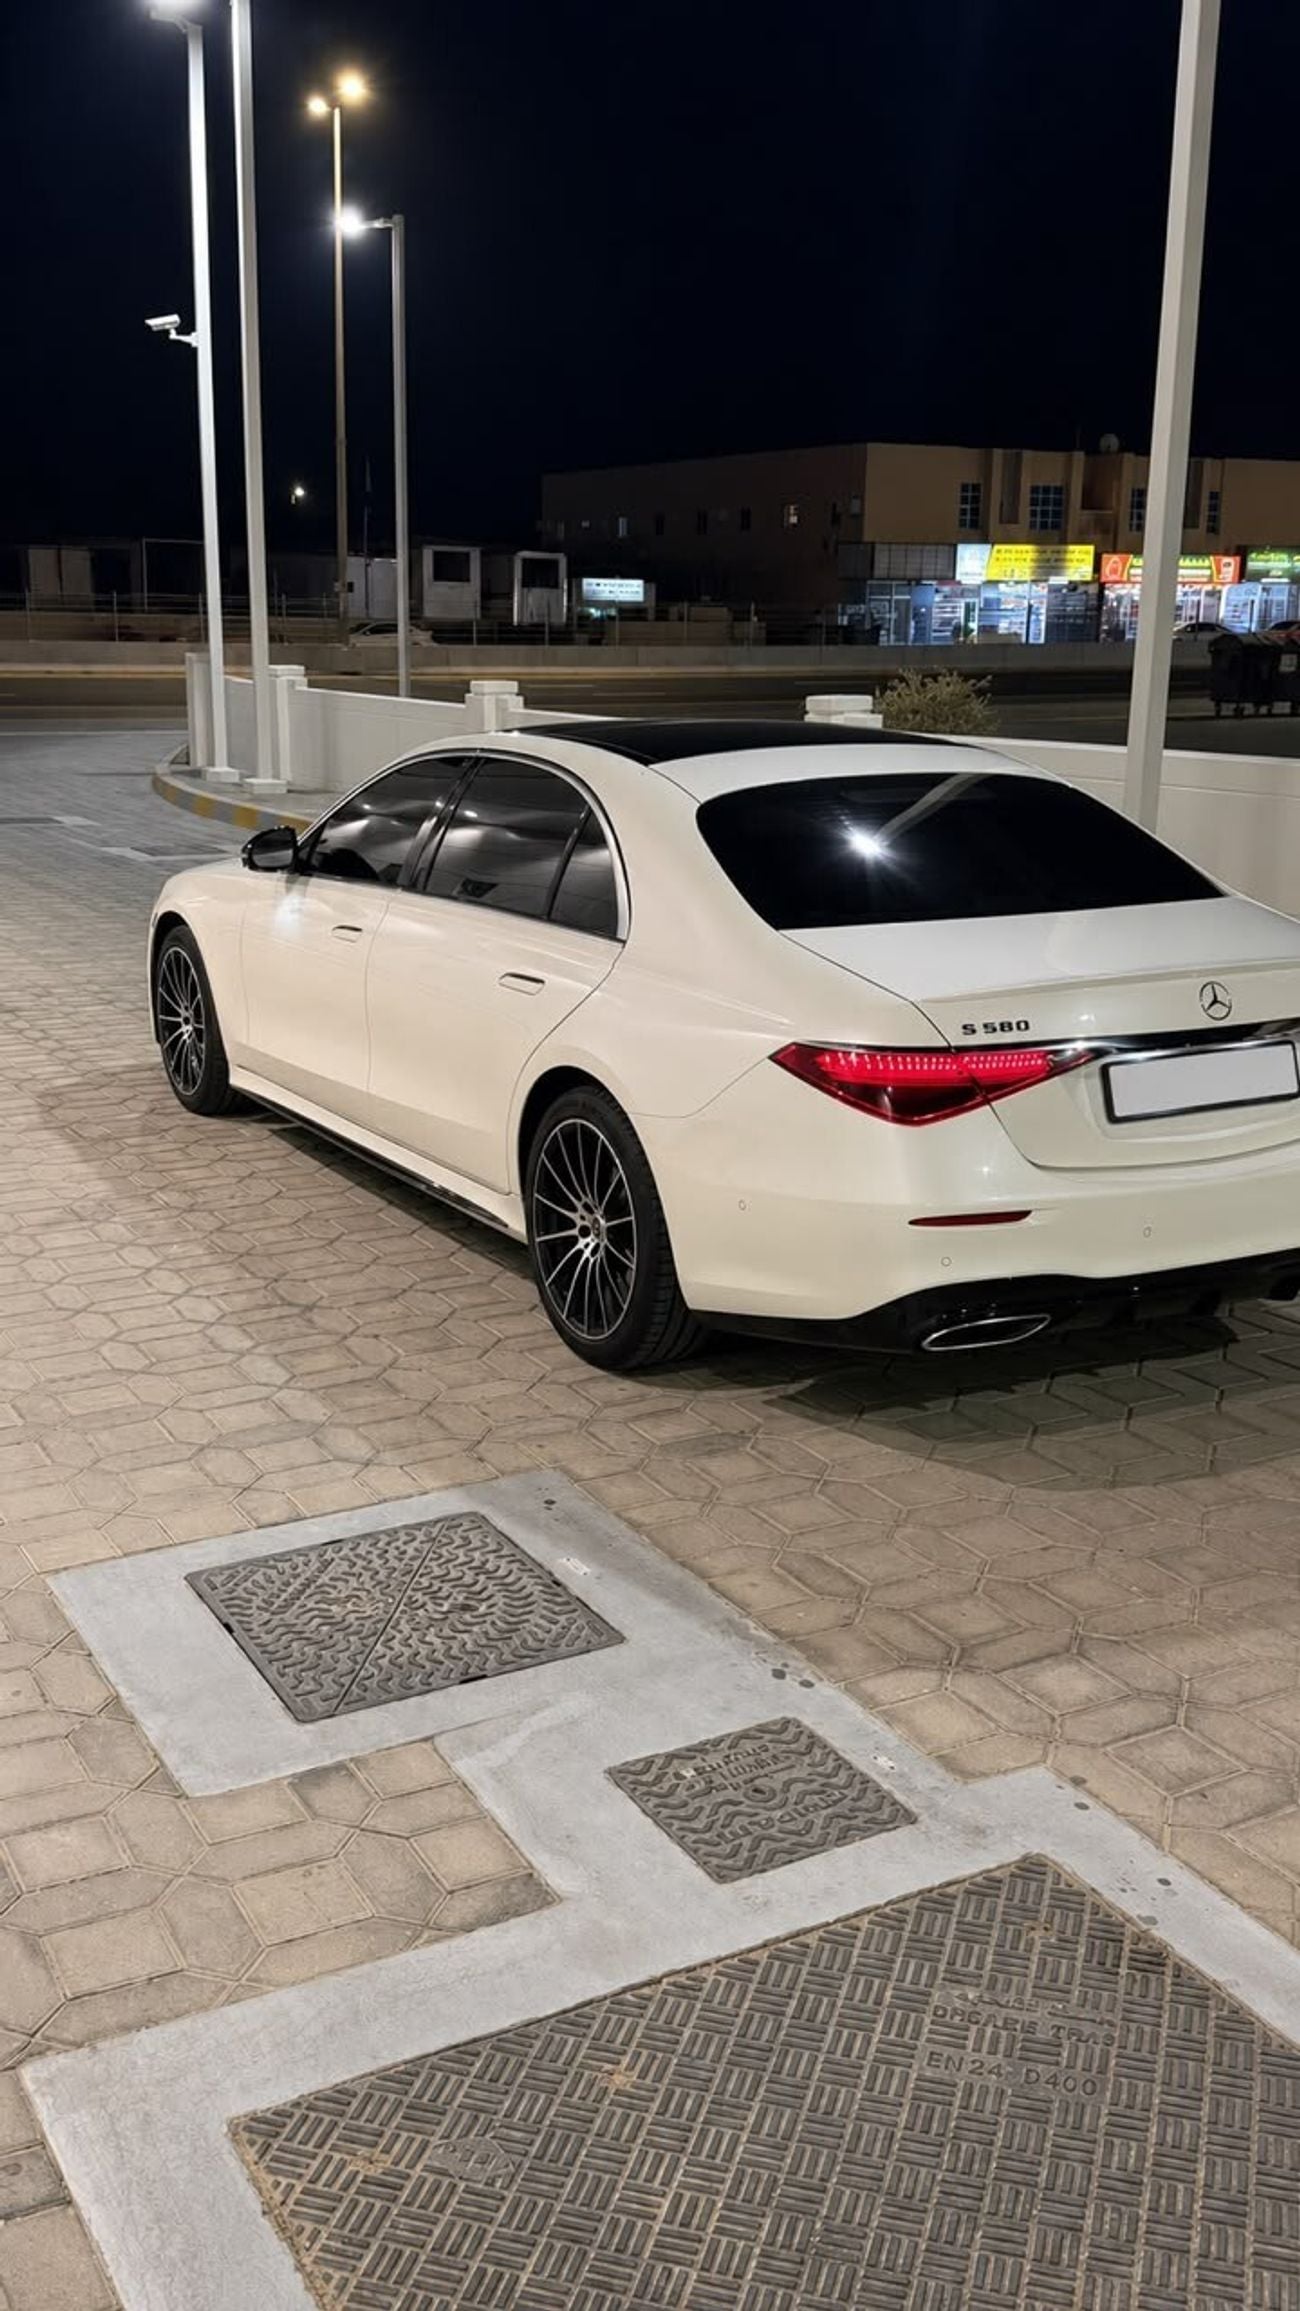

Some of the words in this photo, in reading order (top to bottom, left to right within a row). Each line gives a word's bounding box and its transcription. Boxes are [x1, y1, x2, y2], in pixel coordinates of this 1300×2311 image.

[961, 1023, 977, 1036] S
[982, 1019, 1030, 1034] 580
[1024, 2067, 1097, 2096] D400
